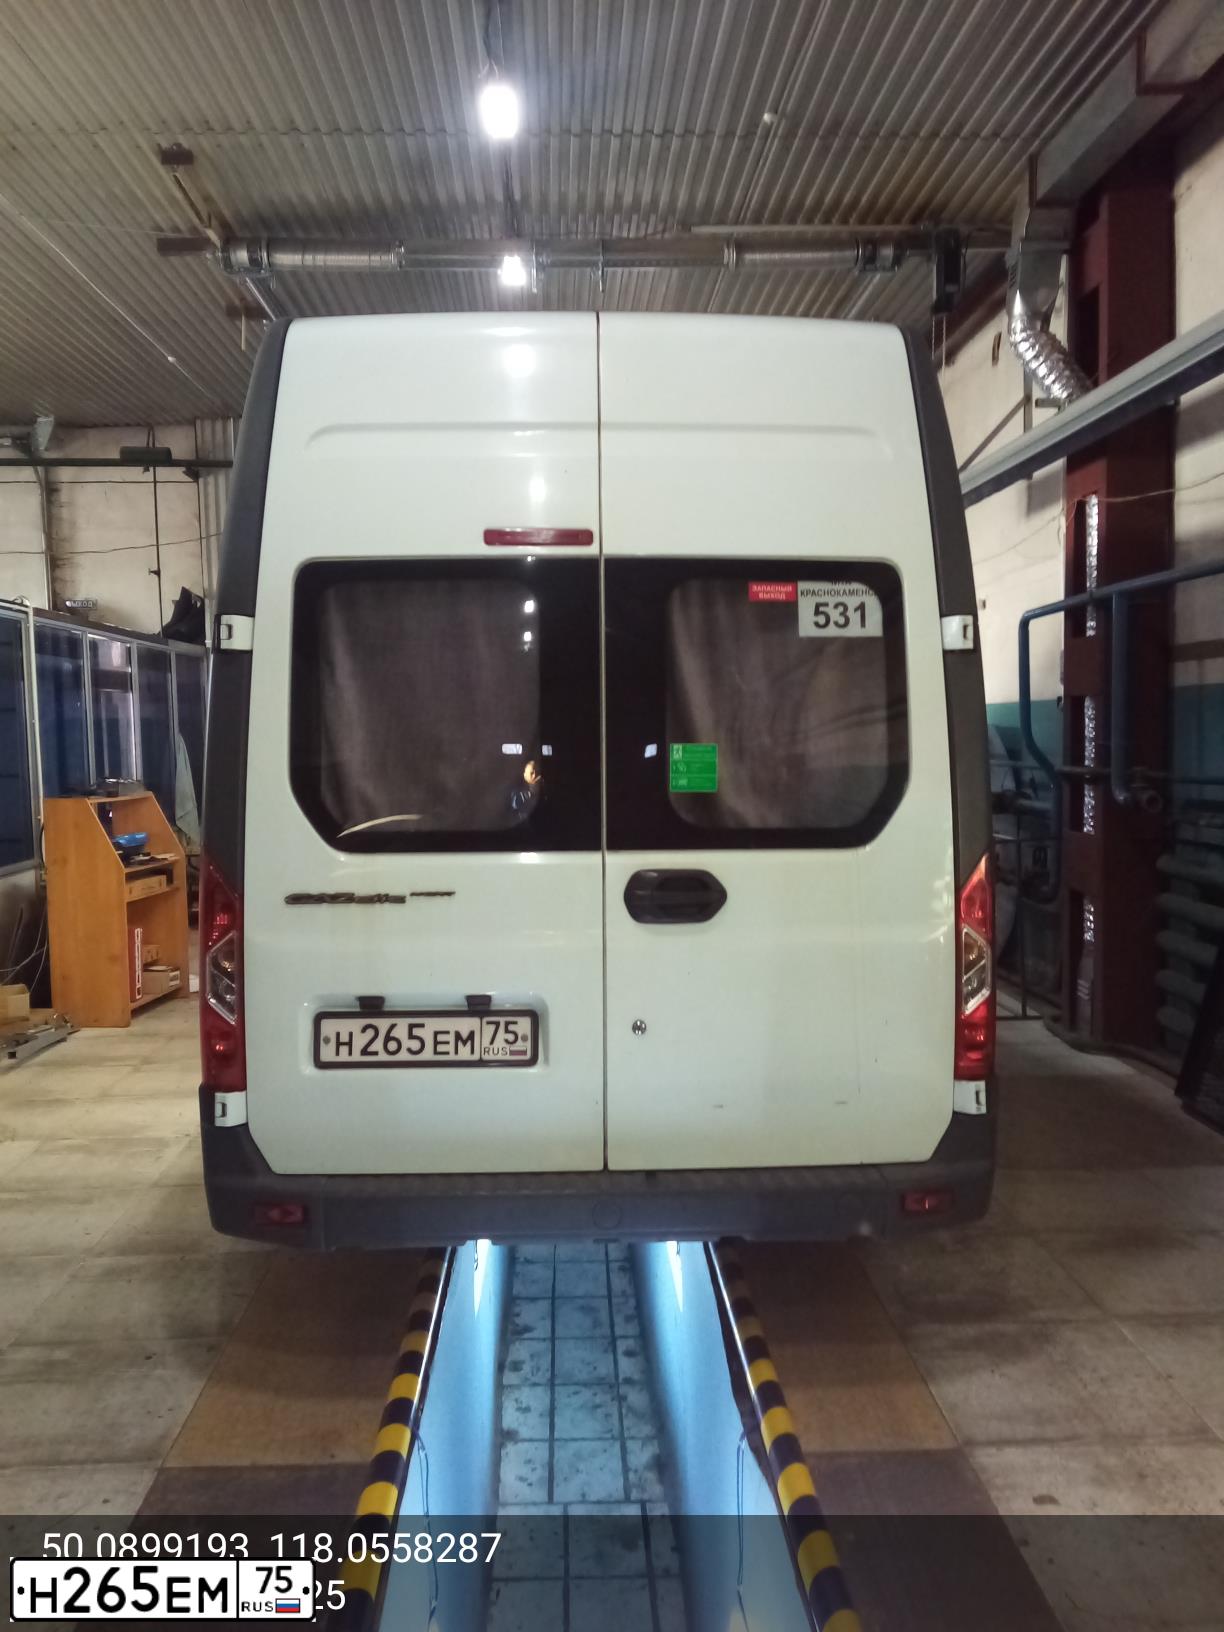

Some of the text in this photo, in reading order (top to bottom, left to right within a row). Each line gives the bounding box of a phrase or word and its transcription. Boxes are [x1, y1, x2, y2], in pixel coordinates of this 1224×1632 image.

[752, 584, 792, 592] ЗАПАСНЫЙ
[758, 592, 786, 600] ВЫХОД
[65, 600, 93, 608] ЫХОД
[813, 602, 866, 629] 531
[486, 1020, 519, 1045] 75
[483, 1047, 508, 1056] RUS
